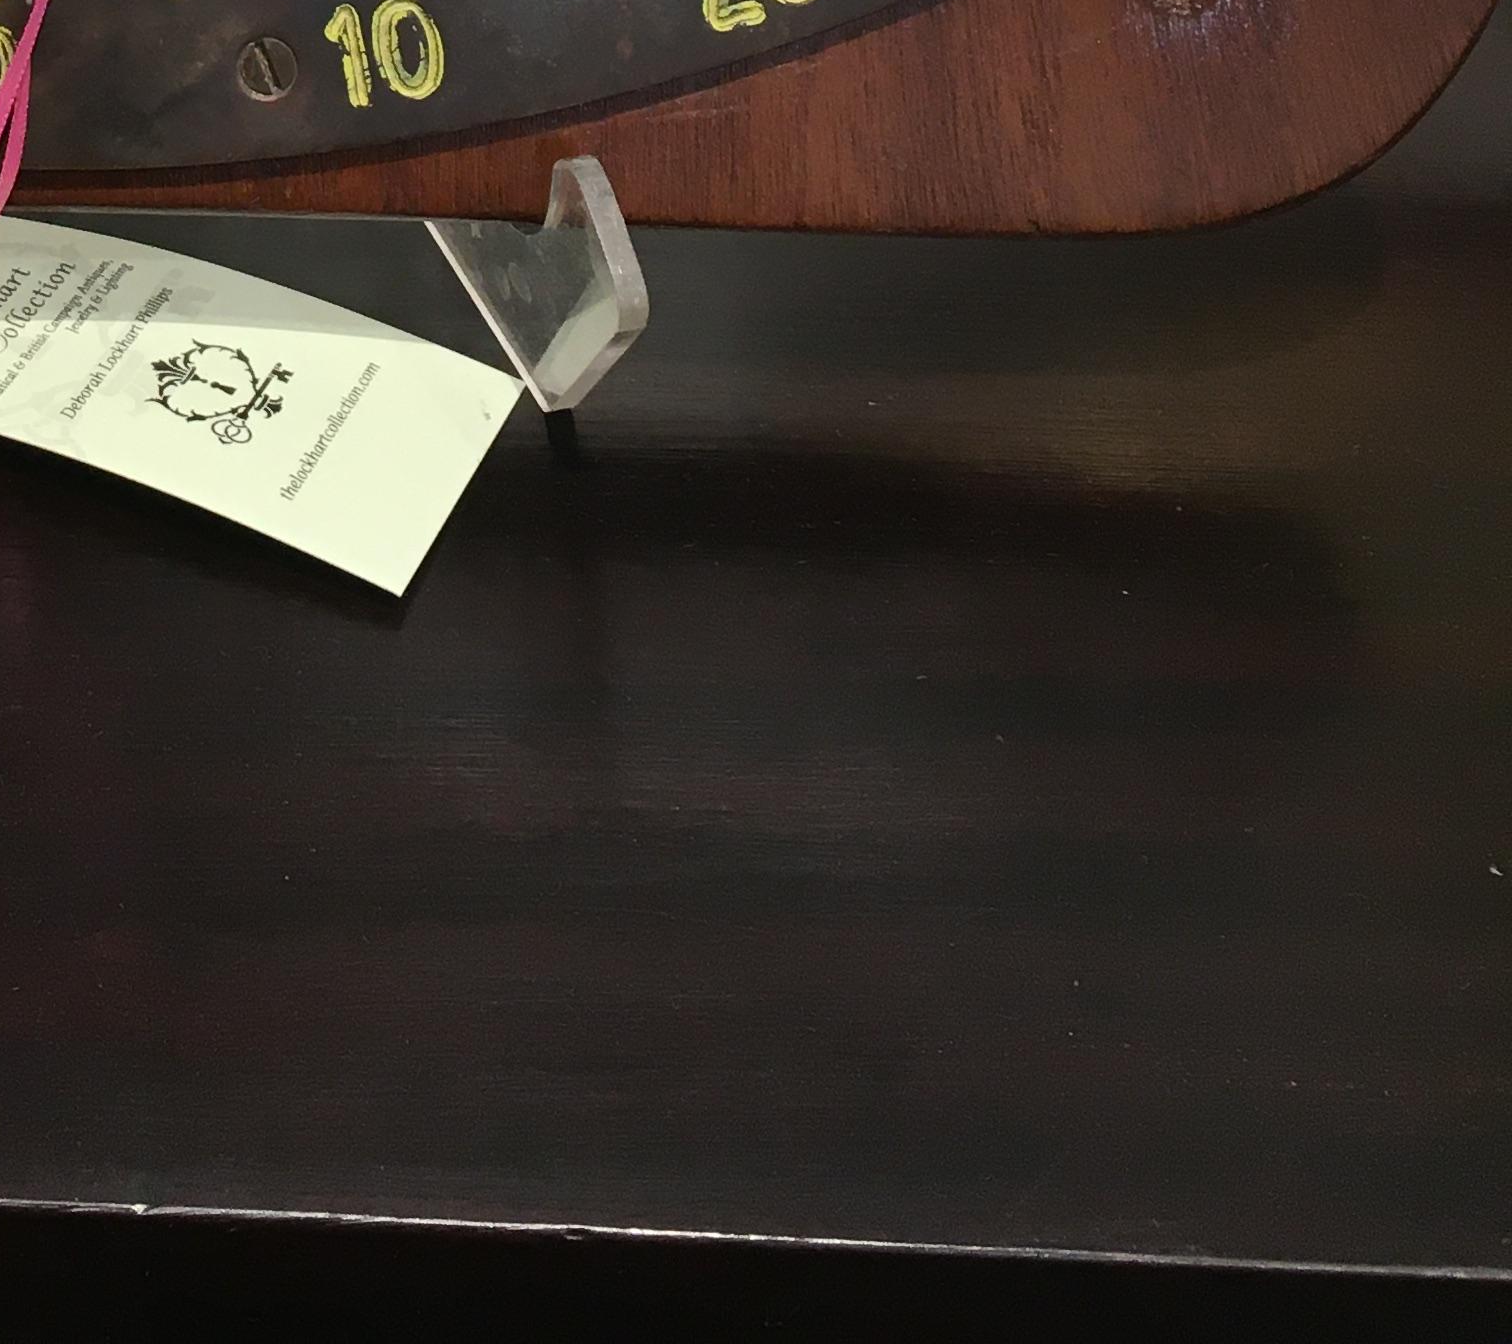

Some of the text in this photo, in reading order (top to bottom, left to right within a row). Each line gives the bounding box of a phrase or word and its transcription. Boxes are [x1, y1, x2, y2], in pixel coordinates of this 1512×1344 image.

[20, 333, 48, 363] British
[46, 294, 83, 334] Campaign
[101, 261, 134, 297] Lighting
[60, 286, 174, 420] Deborah Lockhart Phillips
[280, 361, 381, 502] thelockhartcollection.com
